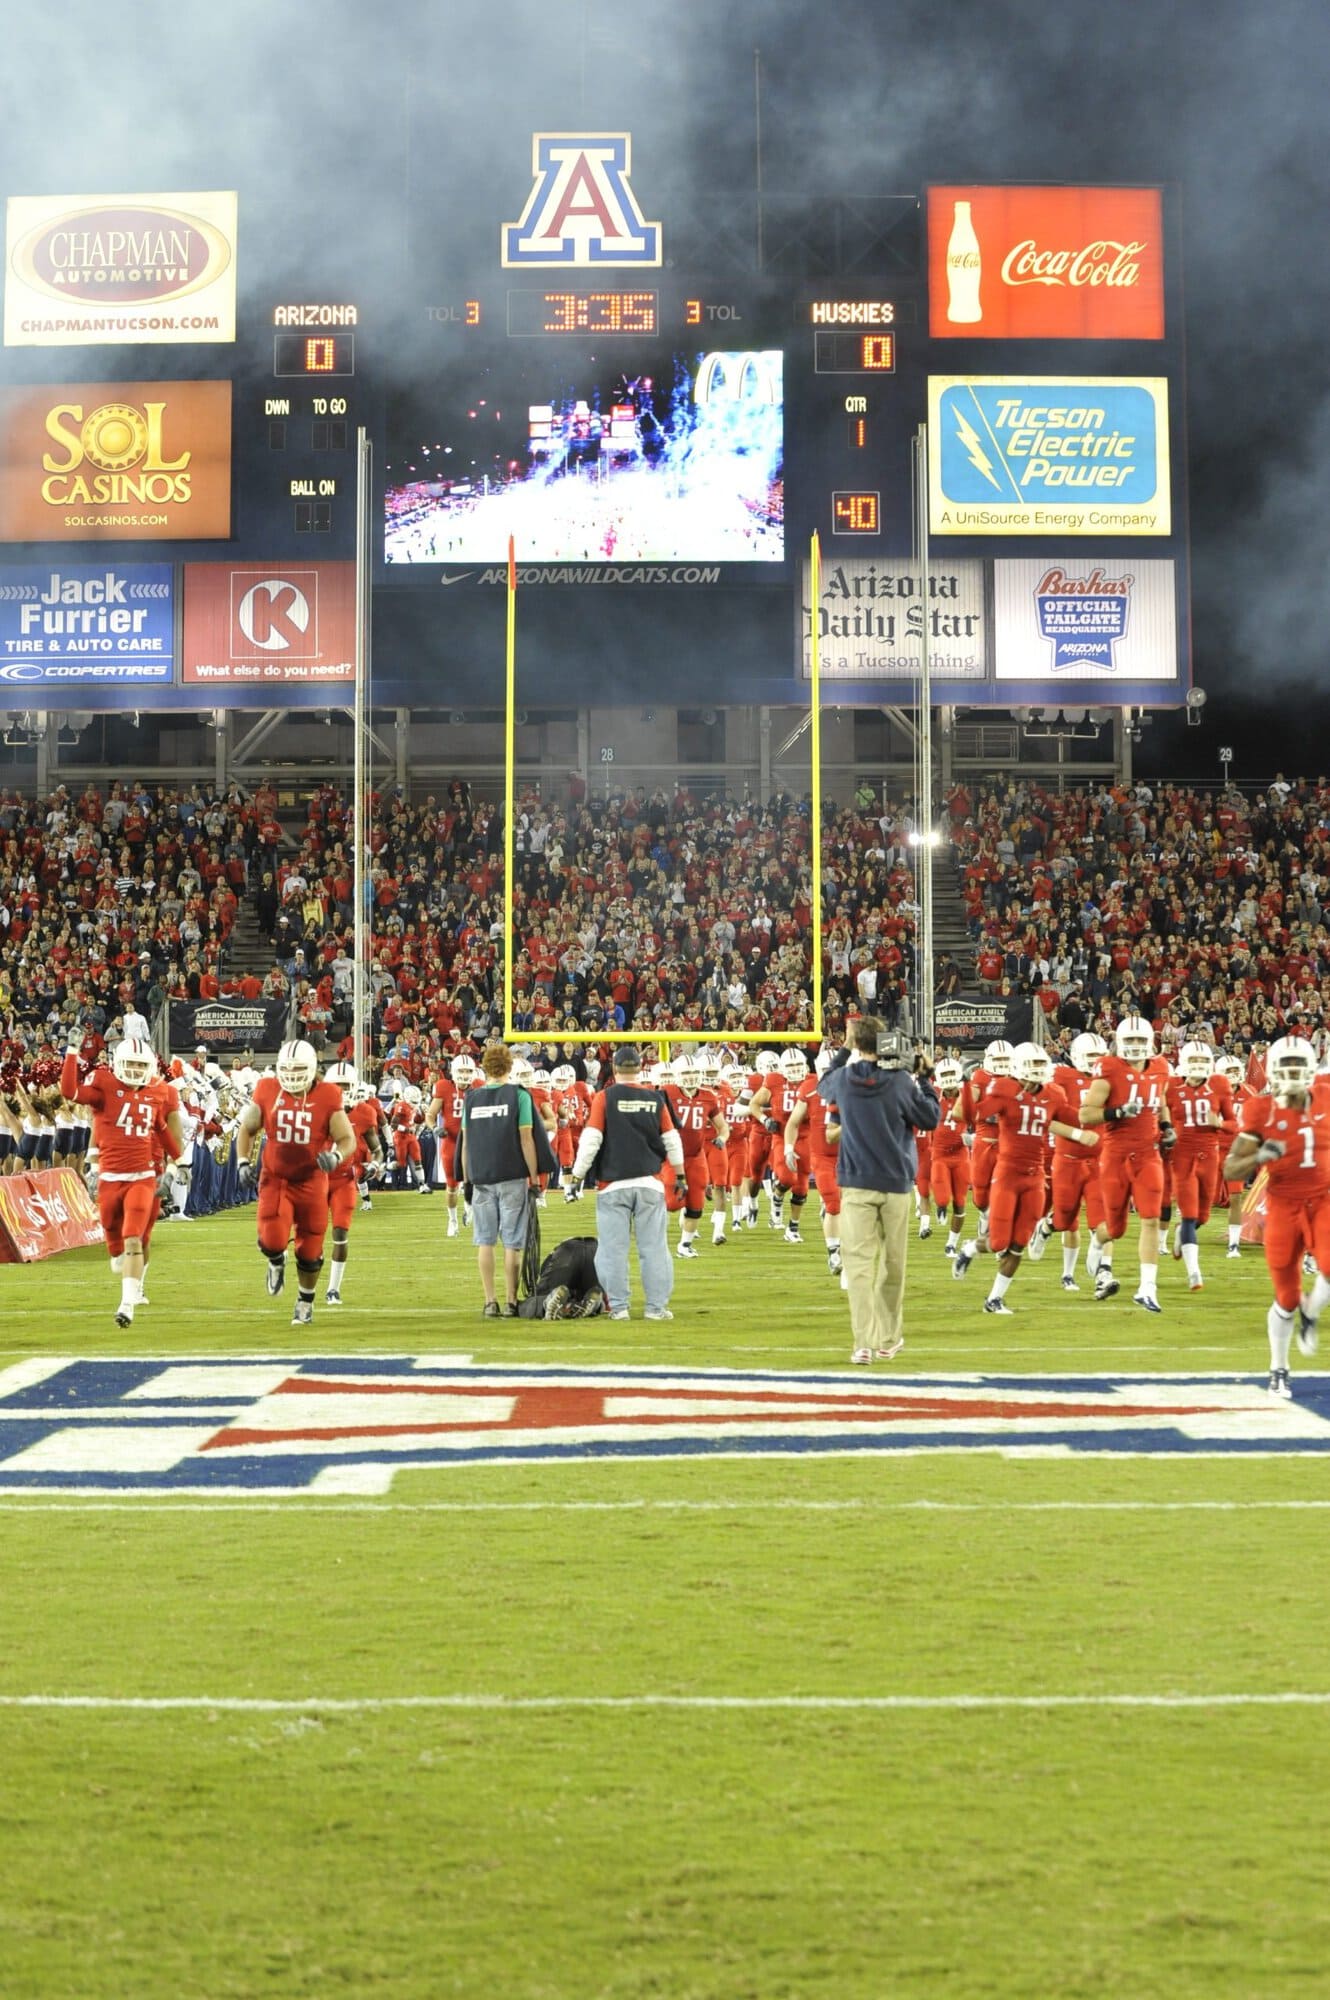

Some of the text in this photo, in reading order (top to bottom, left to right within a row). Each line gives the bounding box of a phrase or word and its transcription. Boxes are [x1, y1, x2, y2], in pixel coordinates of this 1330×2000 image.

[507, 138, 656, 262] A
[49, 230, 192, 268] CHAPMAN
[1001, 240, 1147, 287] Coca-Cola
[52, 267, 189, 284] AUTOMOTIVE
[275, 305, 357, 326] ARIZONA
[426, 301, 480, 324] TOL 3
[544, 295, 654, 330] 3:35
[686, 300, 741, 324] 3 TOL
[812, 302, 894, 323] HUSKIES
[20, 316, 220, 333] CHAPMANTUCSON.COM
[306, 338, 335, 371] 0
[864, 335, 891, 368] 0
[265, 398, 347, 415] DWN TO GO
[845, 396, 867, 412] QTR
[995, 399, 1105, 429] Tucson
[42, 402, 192, 474] SOL
[858, 419, 864, 447] 1
[1006, 429, 1136, 458] Electric
[1020, 458, 1136, 487] Power
[41, 473, 192, 505] CASINOS
[290, 480, 335, 496] BALL ON
[64, 515, 168, 527] SOLCASINOS.COM
[837, 497, 876, 528] 40
[941, 511, 1157, 528] A UniSource Energy Company
[477, 566, 721, 585] ARZONAWILDCATS.COM
[1038, 570, 1131, 595] Bashas'
[41, 573, 127, 605] Jack
[1044, 600, 1121, 612] OFFICIAL
[21, 603, 148, 634] Furrier
[803, 605, 896, 646] Daily
[1044, 613, 1121, 625] TAILGATE
[1045, 626, 1121, 634] HEADQUARTERS
[6, 638, 163, 652] TIRE & AUTO CARE
[1058, 643, 1109, 653] ARIZONA
[45, 665, 168, 677] COOPERTIRES
[196, 663, 351, 678] What else do you need?
[838, 656, 849, 668] a
[855, 652, 920, 668] Tucson
[601, 748, 614, 761] 28
[1219, 747, 1232, 761] 29
[237, 1011, 265, 1019] FAMILY
[936, 1008, 1006, 1016] AMERICAN FAMILY
[617, 1100, 657, 1114] ESPN
[783, 1091, 800, 1112] 6
[1127, 1084, 1162, 1114] 44
[116, 1102, 153, 1137] 43
[470, 1104, 509, 1120] ESPN
[677, 1106, 704, 1130] 76
[1017, 1105, 1048, 1137] 12
[1181, 1099, 1211, 1127] 18
[276, 1110, 312, 1144] 55
[1297, 1126, 1316, 1168] 1
